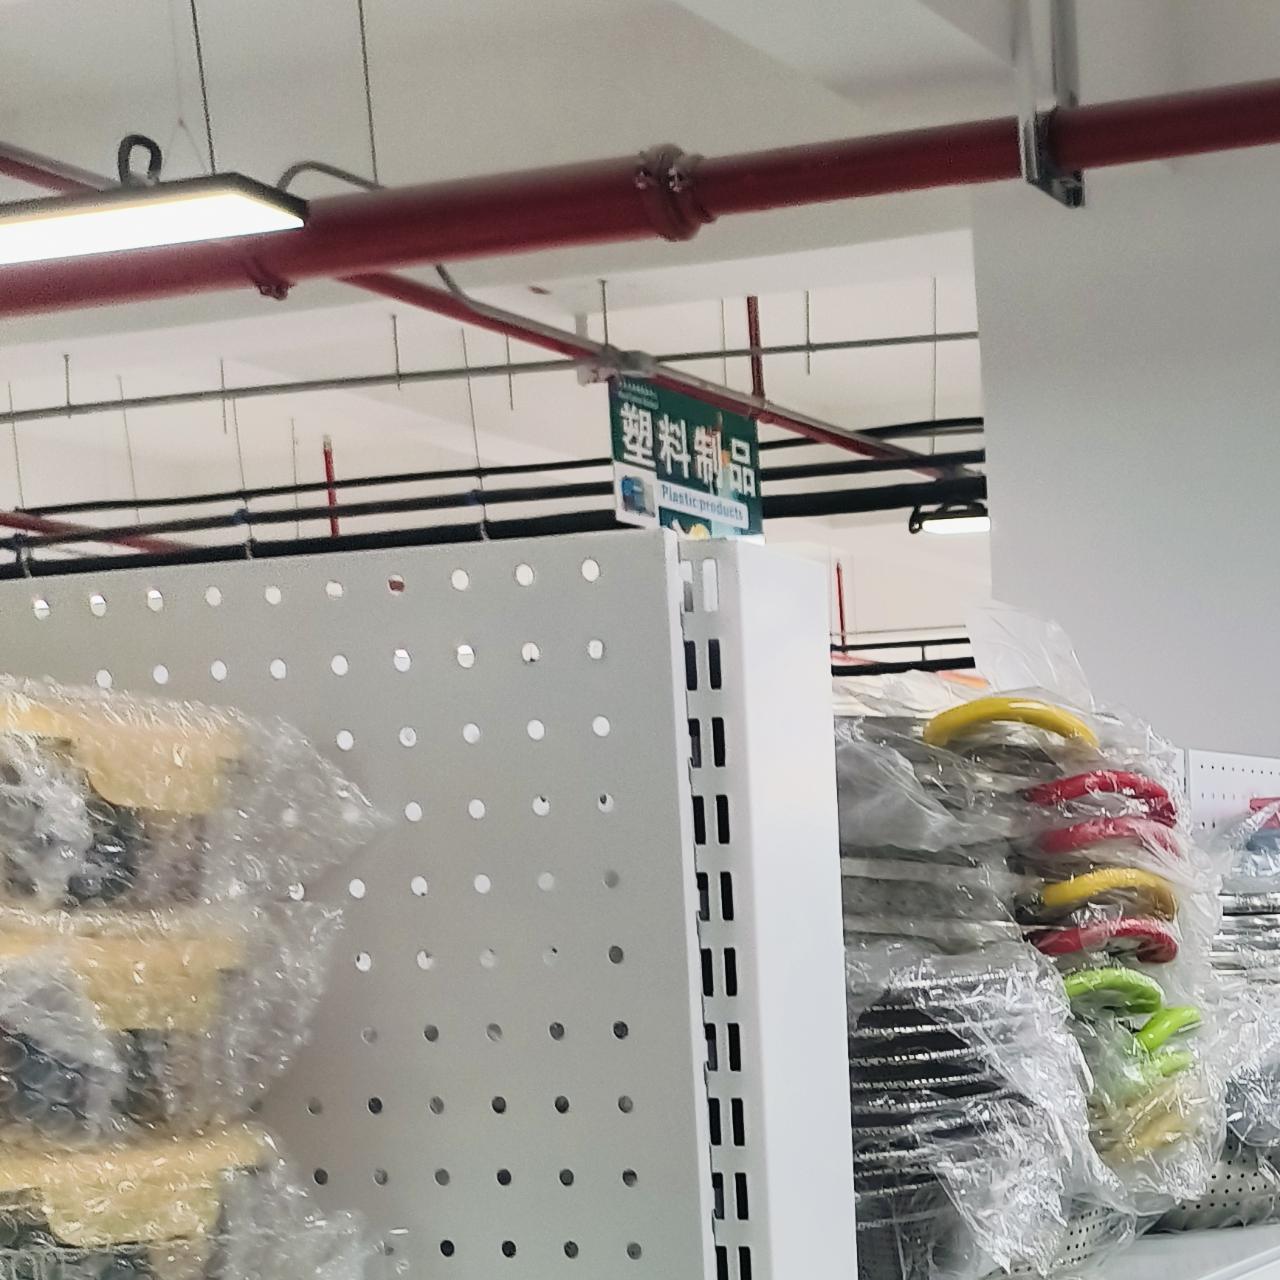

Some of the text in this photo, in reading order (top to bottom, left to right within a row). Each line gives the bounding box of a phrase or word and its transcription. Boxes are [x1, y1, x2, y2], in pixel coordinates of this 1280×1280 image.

[620, 402, 757, 498] 塑料制品
[661, 484, 744, 521] Plastic products
